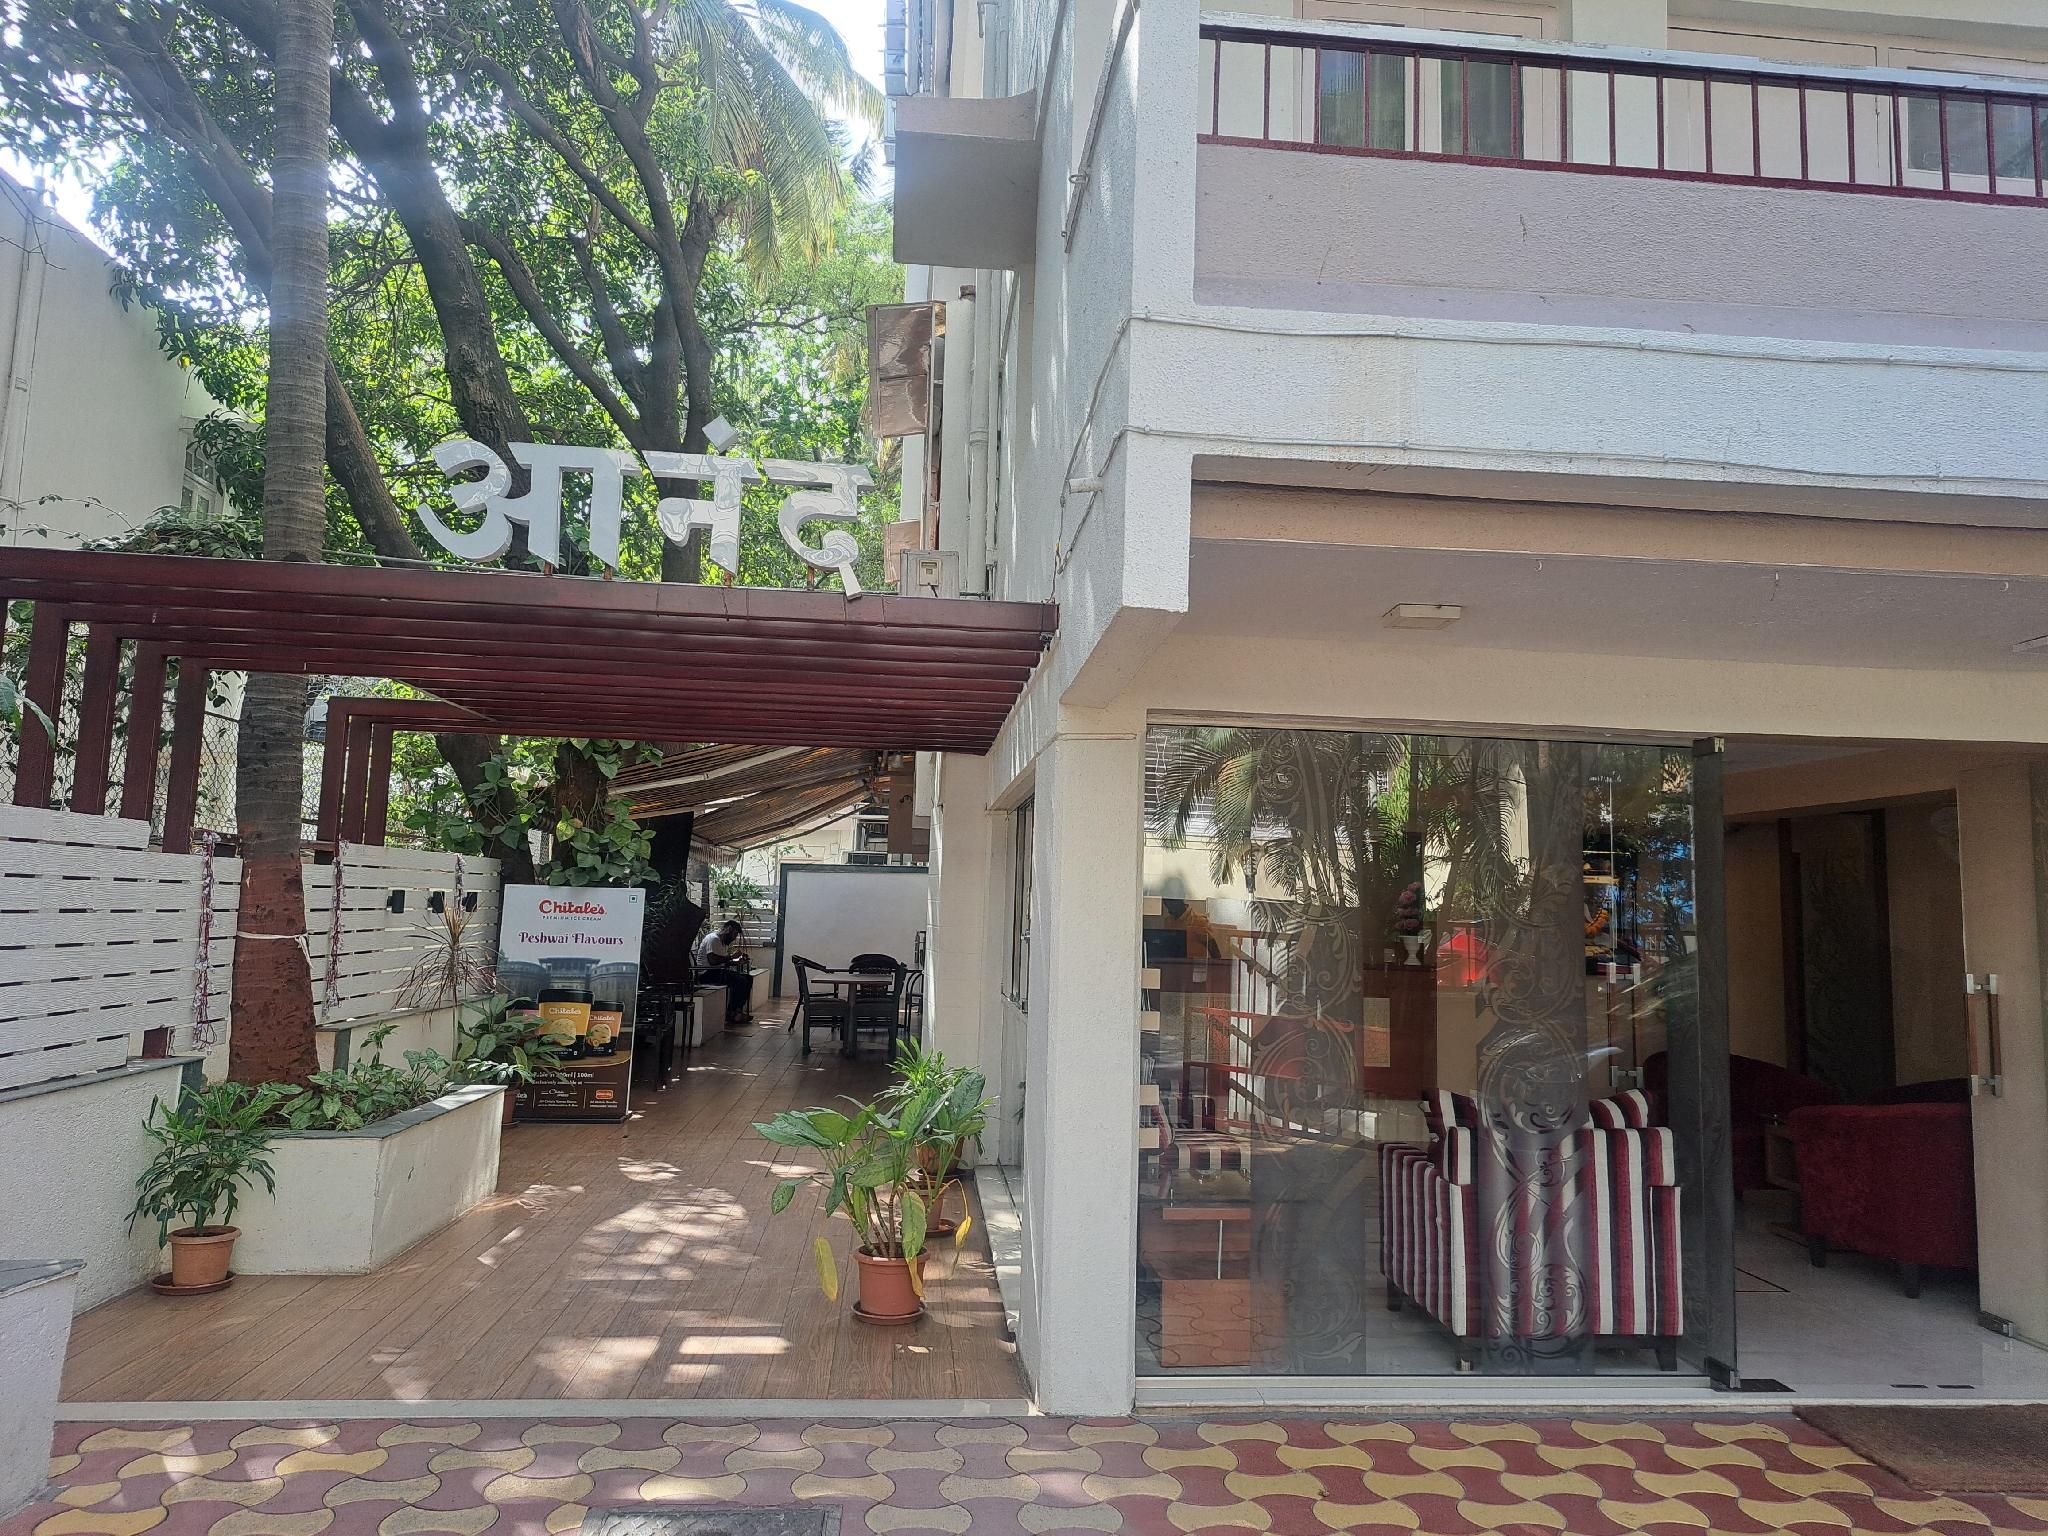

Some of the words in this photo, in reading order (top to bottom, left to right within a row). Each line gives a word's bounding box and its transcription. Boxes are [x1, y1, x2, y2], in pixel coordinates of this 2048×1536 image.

[416, 415, 875, 600] आनंद
[539, 899, 605, 915] Chitale's
[518, 931, 569, 944] Peshwai
[571, 933, 624, 945] Flavours
